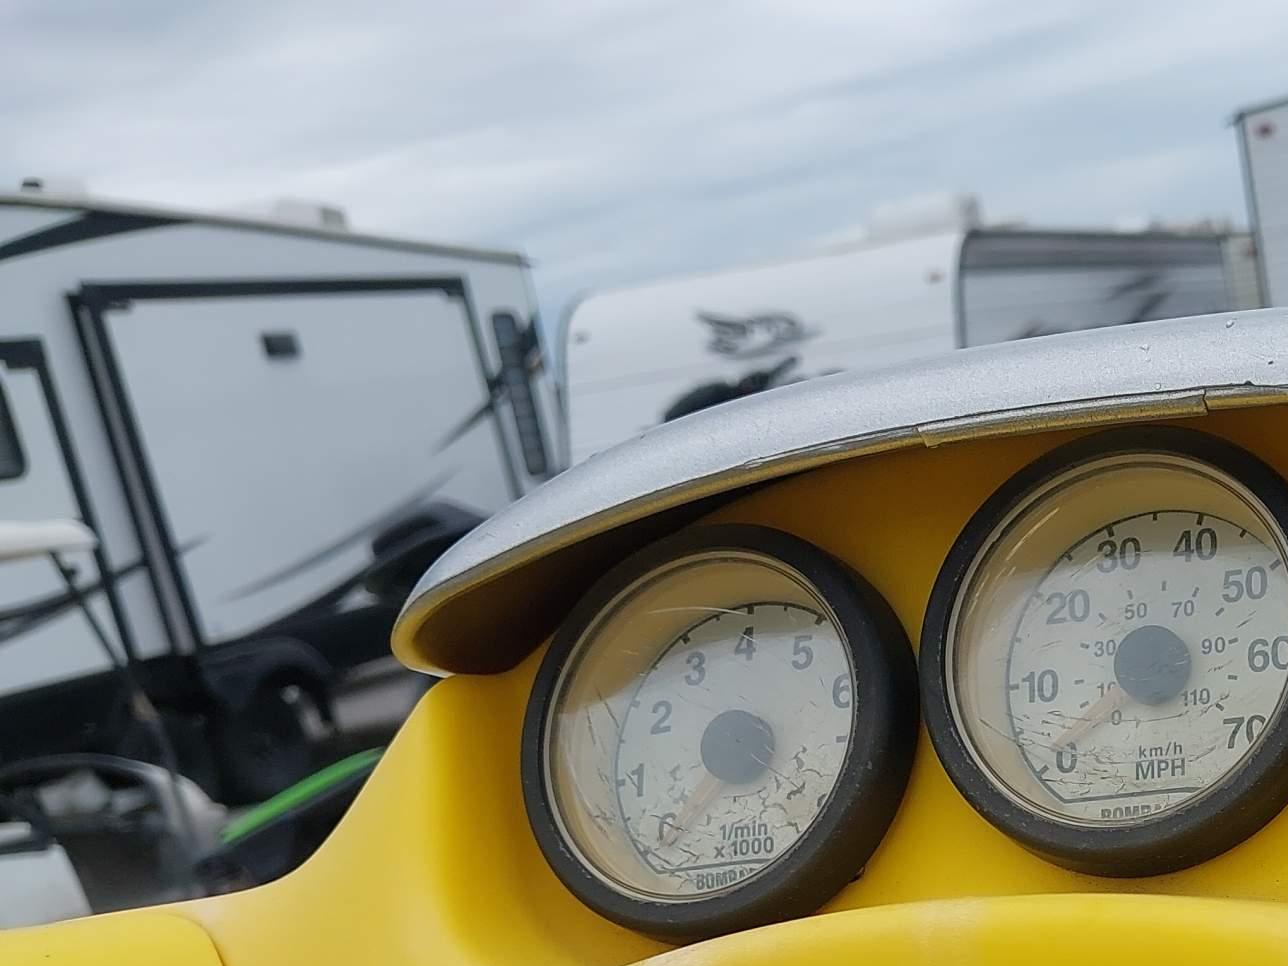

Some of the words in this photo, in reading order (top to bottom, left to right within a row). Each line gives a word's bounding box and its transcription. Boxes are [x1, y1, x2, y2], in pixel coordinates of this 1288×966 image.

[1096, 537, 1141, 572] 30
[1172, 527, 1218, 564] 40
[1222, 565, 1268, 604] 50
[1046, 589, 1090, 626] 20
[1124, 602, 1148, 620] 50
[1171, 600, 1195, 619] 70
[734, 626, 756, 660] 4
[791, 635, 813, 670] 5
[1093, 640, 1117, 658] 30
[1201, 636, 1225, 655] 90
[685, 652, 706, 686] 3
[832, 674, 850, 709] 6
[1022, 669, 1059, 704] 10
[650, 700, 672, 734] 2
[1111, 710, 1122, 725] 0
[1222, 715, 1267, 749] 70
[1056, 742, 1078, 774] 0
[1139, 741, 1182, 759] km/h
[632, 763, 646, 797] 1
[1135, 758, 1186, 781] MPH
[719, 820, 768, 841] 1/min
